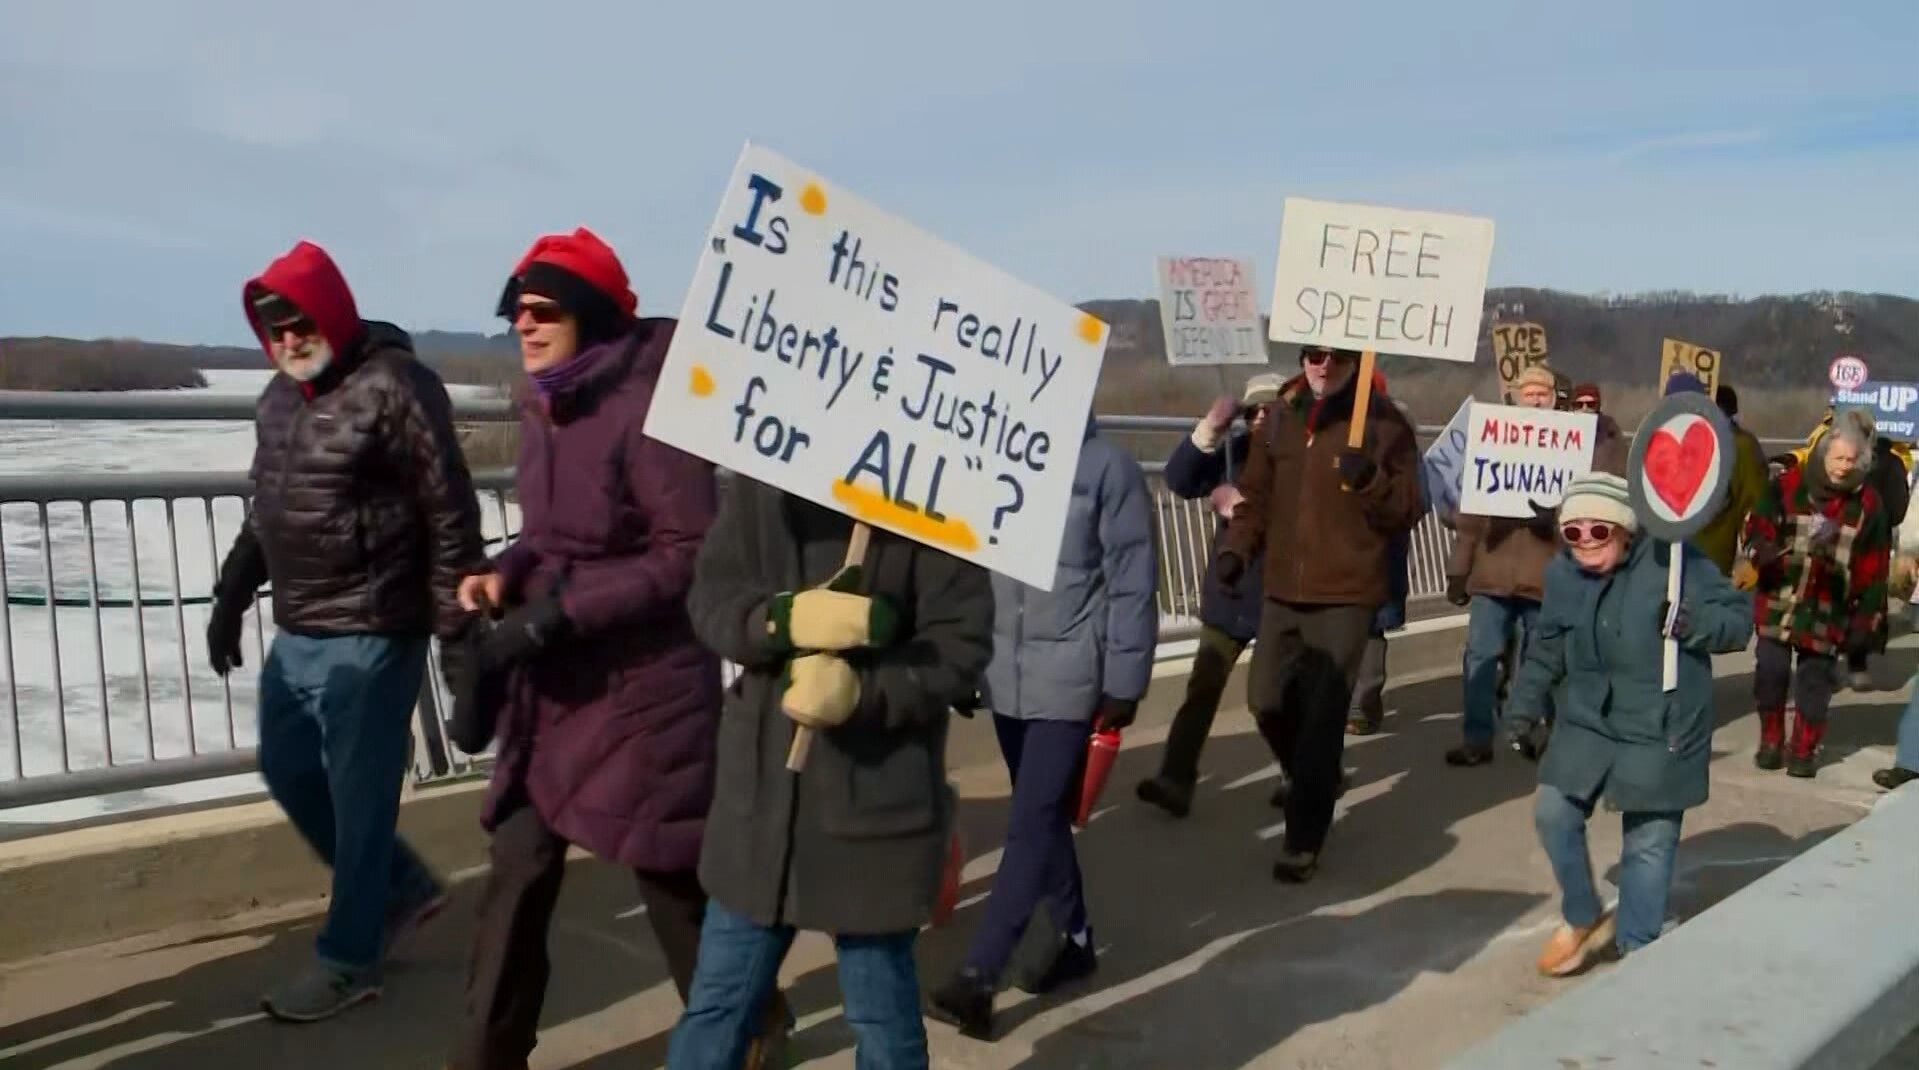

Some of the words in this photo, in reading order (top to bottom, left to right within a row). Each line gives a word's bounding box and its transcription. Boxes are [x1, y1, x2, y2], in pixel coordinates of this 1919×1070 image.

[1319, 223, 1446, 279] FREE
[732, 172, 791, 255] Is
[828, 229, 901, 313] this
[932, 296, 1063, 403] really
[1174, 289, 1197, 321] IS
[1289, 286, 1455, 348] SPEECH
[1495, 327, 1543, 353] ICE
[733, 376, 811, 464] for
[900, 352, 1052, 472] Justice
[1879, 386, 1918, 412] UP
[1481, 418, 1581, 451] MIDTERM
